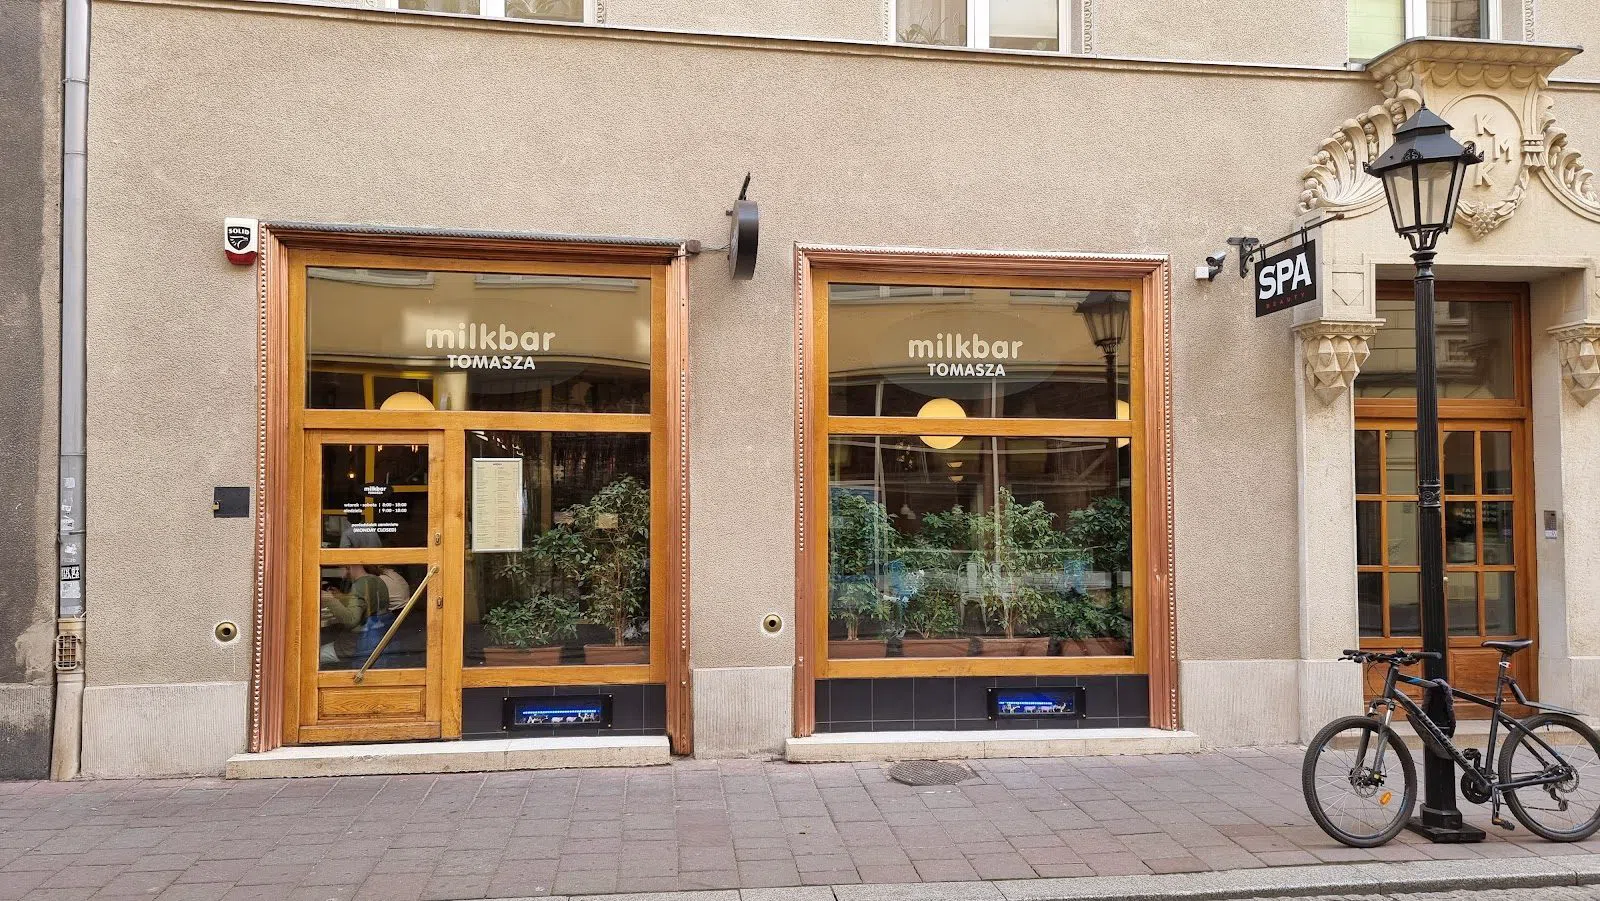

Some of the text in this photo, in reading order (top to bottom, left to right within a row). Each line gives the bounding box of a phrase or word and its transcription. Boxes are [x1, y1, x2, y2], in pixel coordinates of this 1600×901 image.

[1259, 252, 1312, 300] SPA
[1266, 292, 1305, 309] BEAUTY
[425, 322, 556, 351] milkbar
[908, 333, 1024, 359] milkbar
[447, 354, 535, 370] TOMASZA
[927, 363, 1006, 377] TOMASZA
